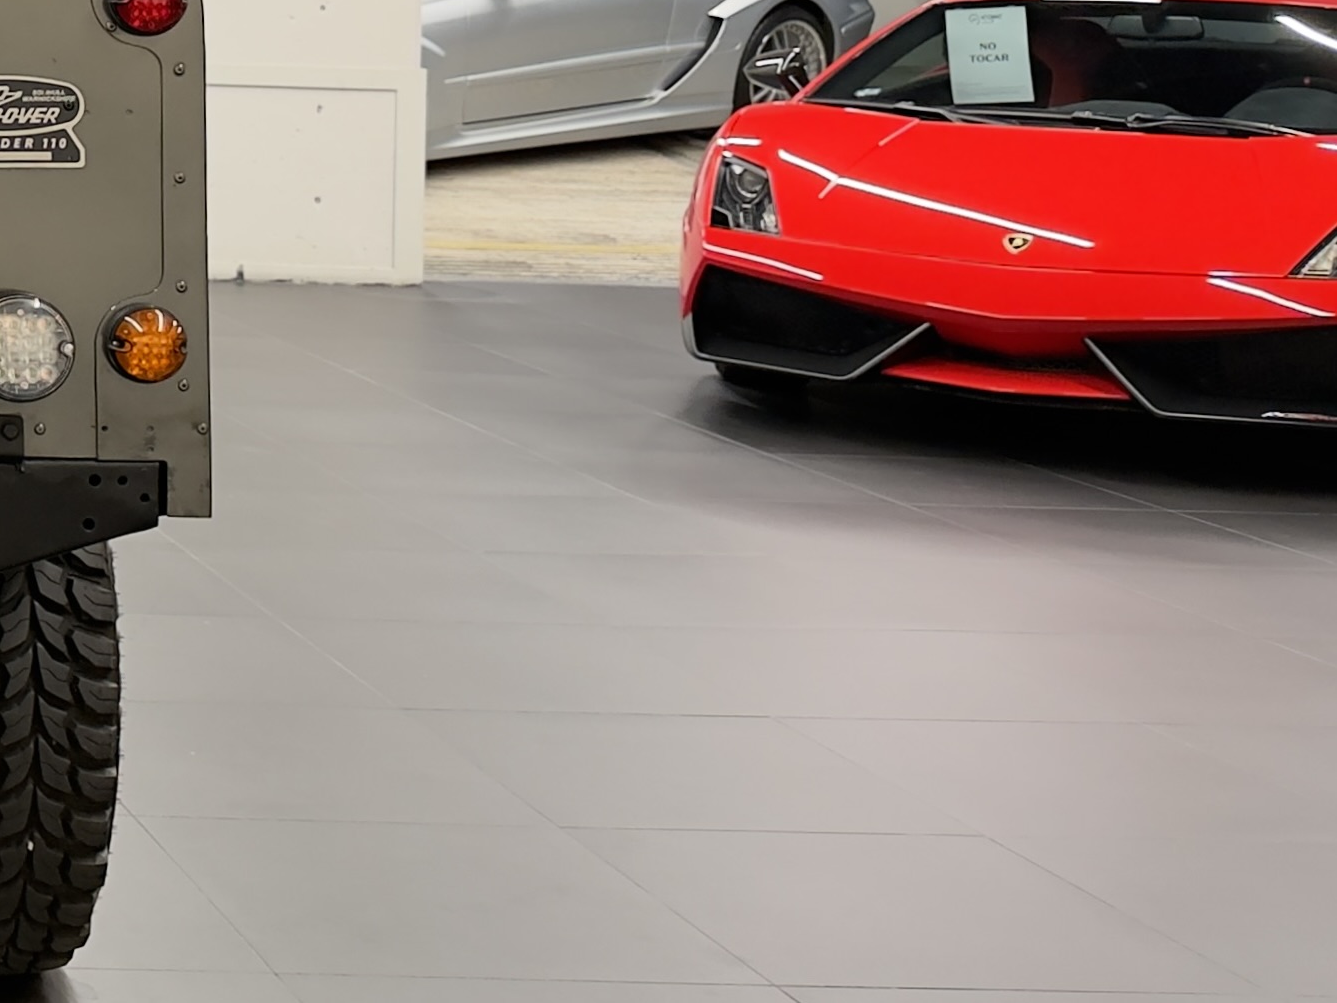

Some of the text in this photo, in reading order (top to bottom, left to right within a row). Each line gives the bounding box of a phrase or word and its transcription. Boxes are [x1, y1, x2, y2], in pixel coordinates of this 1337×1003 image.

[979, 42, 997, 50] NO
[969, 53, 1009, 63] TOCAR
[42, 136, 68, 149] 110
